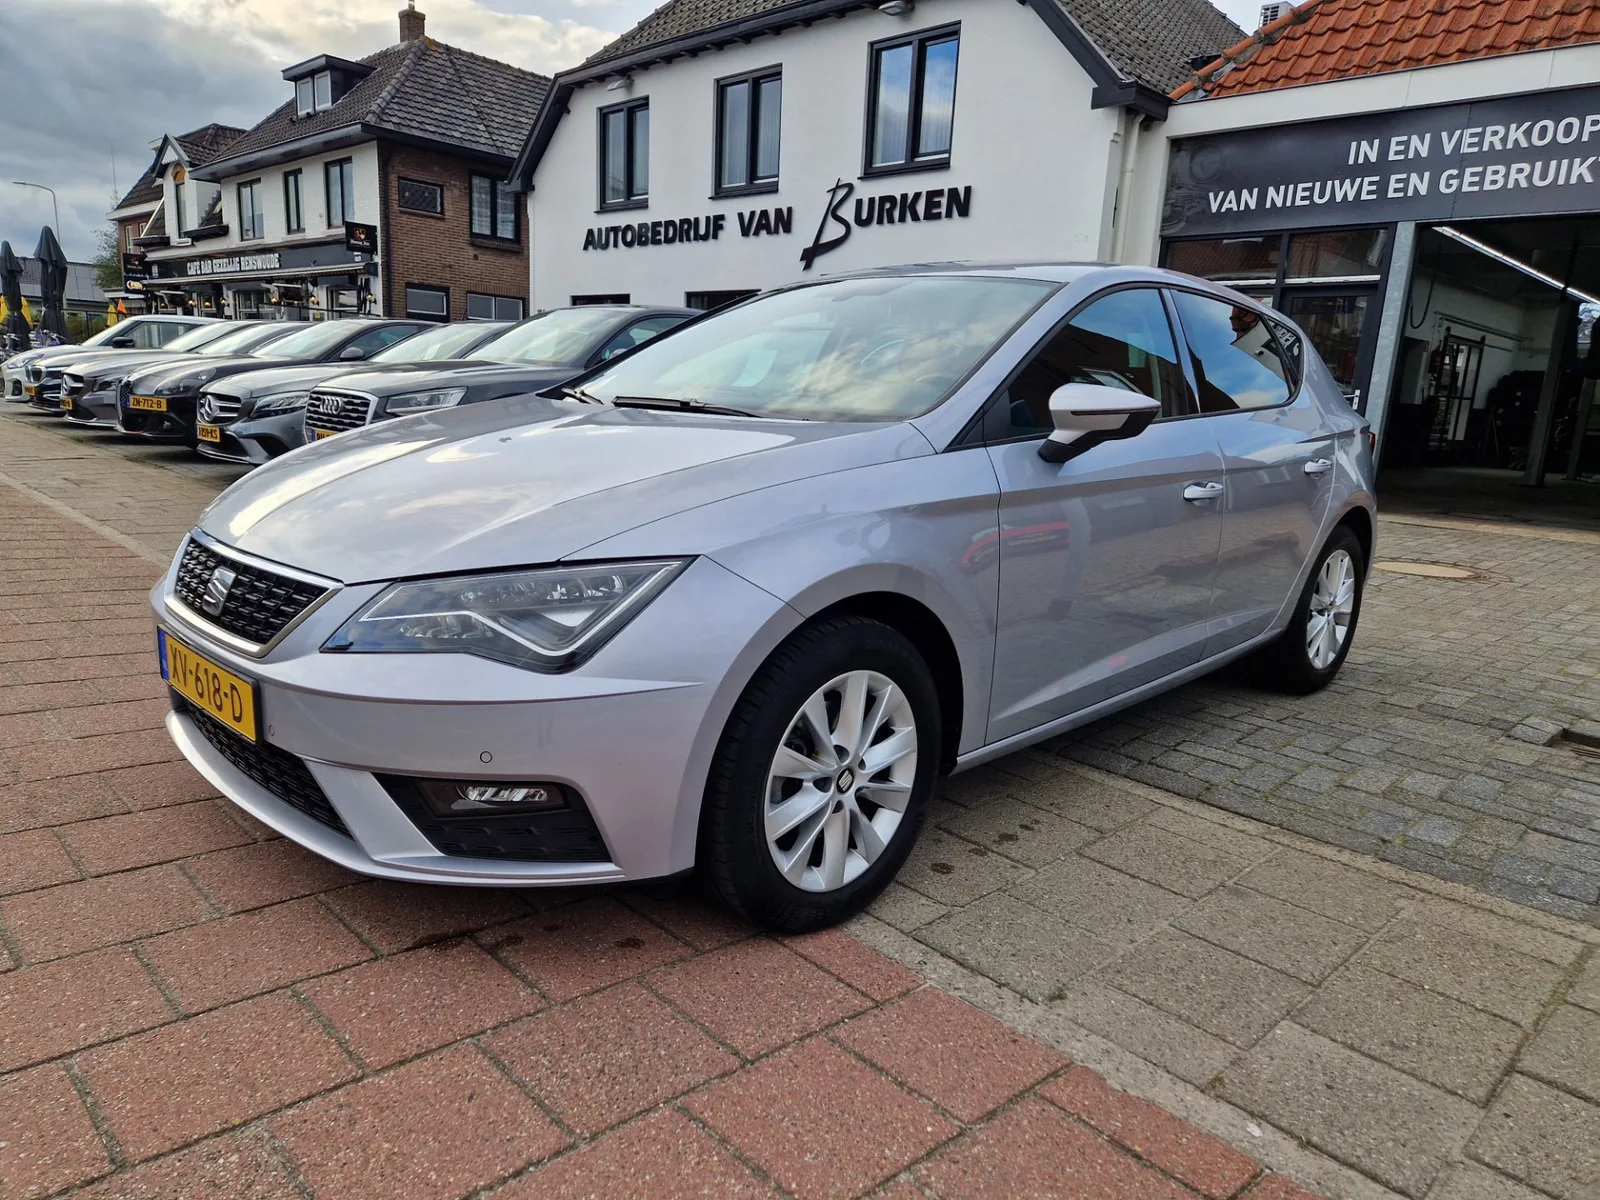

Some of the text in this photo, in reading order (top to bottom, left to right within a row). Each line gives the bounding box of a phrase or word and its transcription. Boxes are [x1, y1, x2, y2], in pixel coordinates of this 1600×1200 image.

[1348, 114, 1600, 165] IN EN VERKOOP
[1208, 156, 1600, 213] VAN NIEUWE EN GEBRUIK
[582, 213, 726, 252] AUTOBEDRIJF
[737, 206, 793, 238] VAN
[201, 259, 213, 274] BAR
[132, 397, 163, 409] ZN-712-B
[169, 643, 243, 724] XV-618-D
